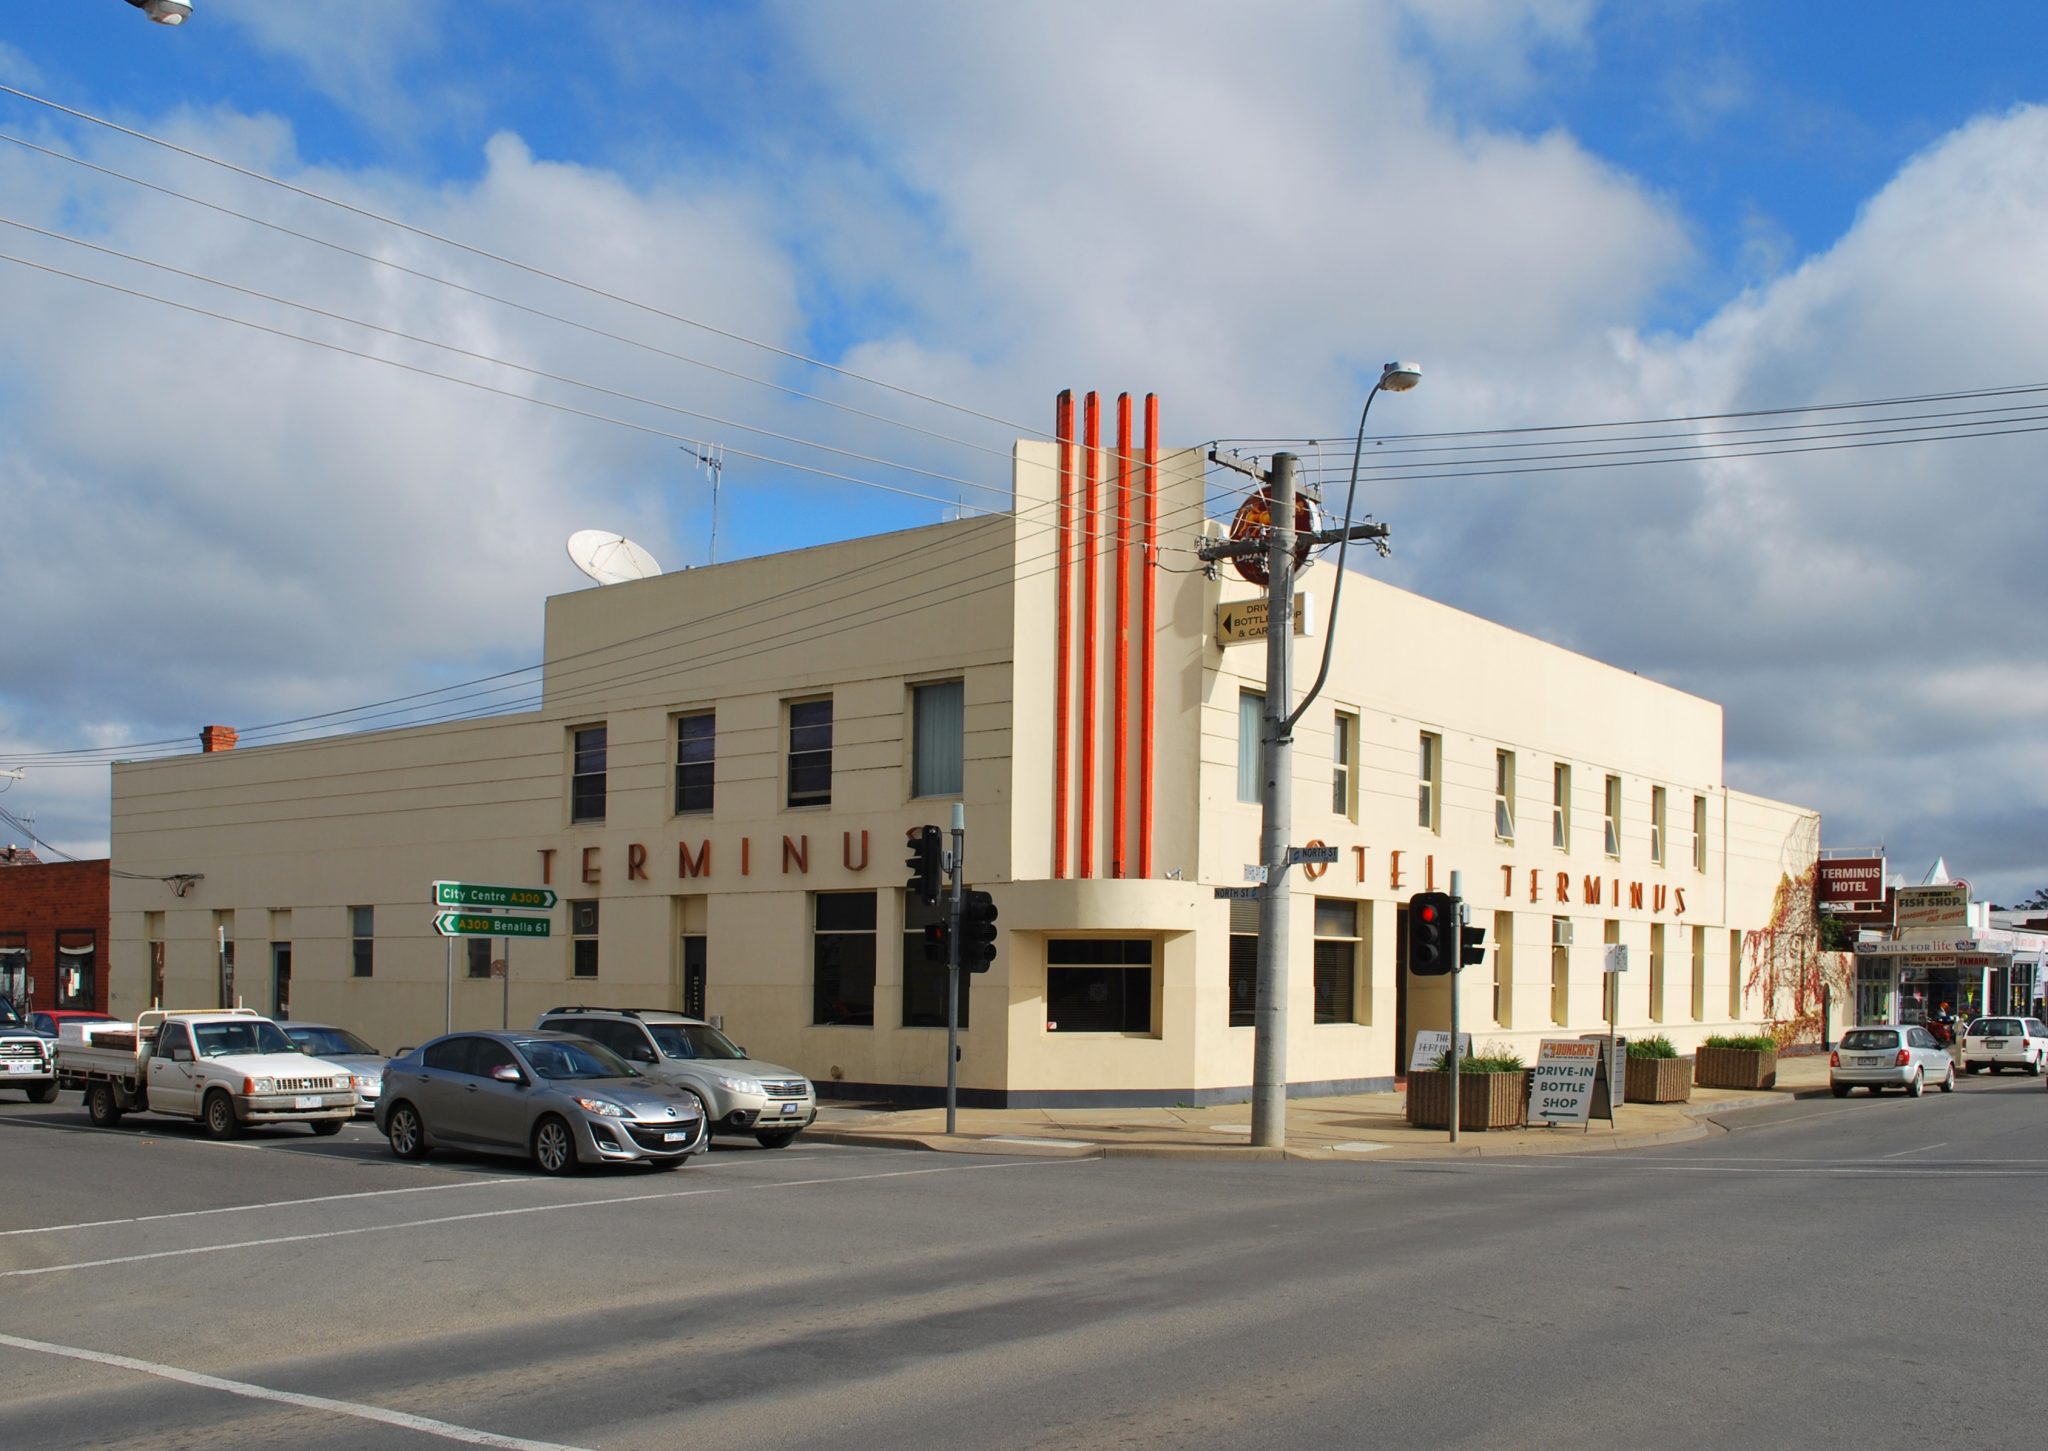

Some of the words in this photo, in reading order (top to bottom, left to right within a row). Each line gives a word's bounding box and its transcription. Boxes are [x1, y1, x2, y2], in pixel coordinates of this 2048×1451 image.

[1234, 615, 1269, 627] BOTTL
[1302, 848, 1327, 858] NORTH
[1328, 848, 1337, 857] ST
[1259, 836, 1440, 892] OTEL
[1821, 867, 1881, 880] TERMINUS
[1501, 863, 1686, 916] TERMINUS
[1831, 881, 1869, 892] HOTEL
[443, 888, 466, 901] City
[471, 890, 506, 901] Centre
[511, 893, 540, 903] A300
[1215, 888, 1239, 898] NORTH
[1240, 888, 1249, 897] ST
[1899, 898, 1924, 907] FISH
[1928, 897, 1961, 907] SHOP
[459, 919, 489, 930] A300
[494, 920, 532, 932] Benalla
[535, 923, 547, 932] 61
[1881, 944, 1908, 952] MILK
[1911, 943, 1930, 951] FOR
[1933, 940, 1952, 951] life
[1958, 957, 1989, 966] YAMAHA
[1556, 1043, 1595, 1057] DUNCAN'S
[1537, 1065, 1594, 1077] DRIVE-IN
[1540, 1082, 1586, 1093] BOTTLE
[1542, 1098, 1578, 1108] SHOP
